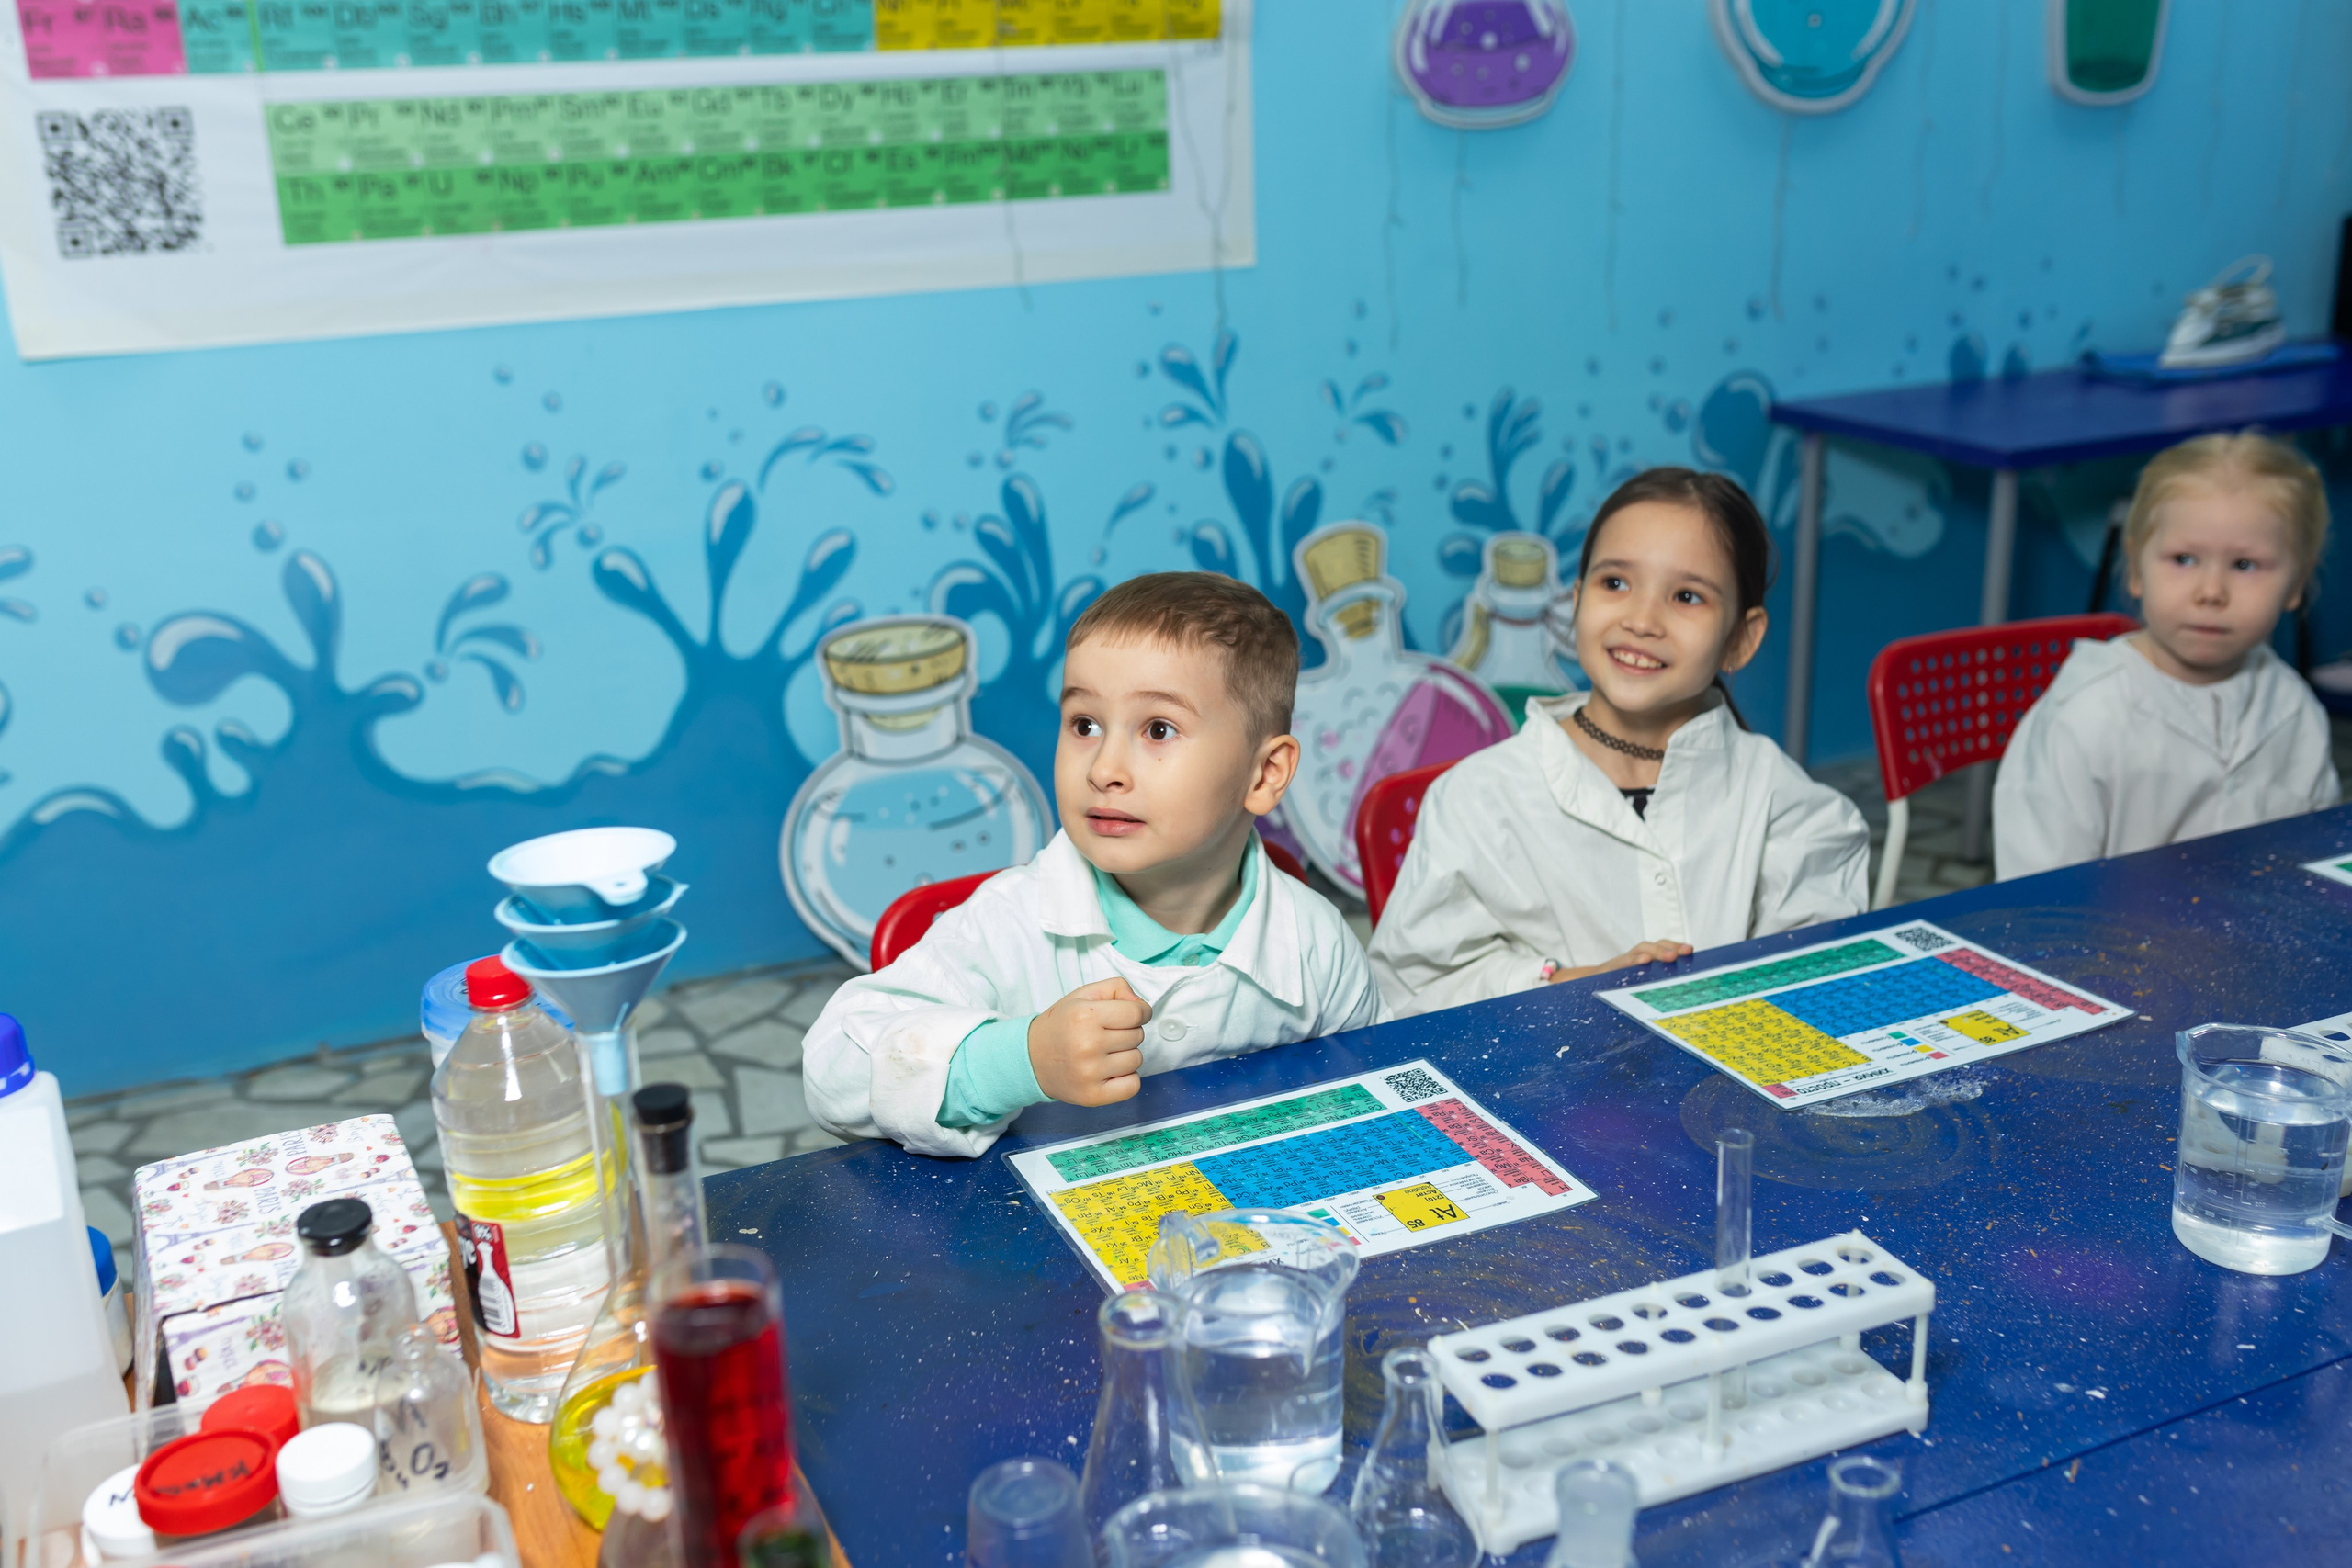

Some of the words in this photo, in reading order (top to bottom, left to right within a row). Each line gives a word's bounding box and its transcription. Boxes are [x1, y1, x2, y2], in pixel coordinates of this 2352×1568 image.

[1352, 1090, 1369, 1099] Th
[1315, 1100, 1325, 1109] U
[1348, 1108, 1361, 1116] Pr
[1409, 1114, 1423, 1122] Ac
[1220, 1121, 1238, 1129] Cm
[1277, 1123, 1295, 1132] Sm
[1446, 1122, 1463, 1130] Ba
[1200, 1125, 1216, 1134] Bk
[1257, 1128, 1273, 1136] Eu
[1425, 1127, 1441, 1135] La
[1483, 1128, 1500, 1136] Rb
[1234, 1134, 1250, 1143] Gd
[1342, 1131, 1360, 1139] Sg
[278, 1130, 308, 1157] PARIS
[1299, 1141, 1316, 1149] Hs
[1190, 1144, 1205, 1152] Dy
[1277, 1146, 1293, 1155] Mt
[1421, 1145, 1435, 1154] Zr
[1478, 1147, 1495, 1156] Ca
[1084, 1152, 1101, 1160] No
[1166, 1149, 1182, 1157] Ho
[1336, 1149, 1352, 1157] Re
[1147, 1155, 1159, 1163] Er
[1118, 1160, 1136, 1168] Tm
[1492, 1161, 1512, 1169] Mg
[1096, 1166, 1113, 1174] Yb
[1270, 1165, 1284, 1173] Pt
[1328, 1168, 1344, 1176] Ru
[1539, 1168, 1552, 1177] Li
[1073, 1170, 1089, 1179] Lu
[1165, 1173, 1177, 1181] Fl
[1244, 1170, 1259, 1179] Au
[1304, 1173, 1321, 1182] Rh
[1391, 1170, 1405, 1179] Cr
[1219, 1176, 1237, 1184] Hg
[1364, 1176, 1383, 1185] Mn
[1512, 1175, 1530, 1183] Be
[1201, 1182, 1215, 1190] Tl
[1282, 1179, 1298, 1188] Pd
[1344, 1181, 1360, 1190] Fe
[1115, 1184, 1129, 1192] Lv
[1174, 1188, 1190, 1196] Pb
[1258, 1184, 1273, 1192] Ag
[1319, 1188, 1336, 1196] Co
[1404, 1184, 1432, 1194] Astatine
[1234, 1190, 1250, 1200] Cd
[1299, 1193, 1313, 1201] Ni
[1415, 1189, 1437, 1198] Астат
[254, 1185, 283, 1215] PARIS
[1062, 1196, 1080, 1204] Og
[1125, 1199, 1142, 1207] Po
[1272, 1199, 1289, 1207] Cu
[1103, 1204, 1115, 1213] At
[1187, 1201, 1204, 1210] Sn
[1429, 1203, 1458, 1221] At
[1139, 1213, 1155, 1222] Te
[1407, 1218, 1426, 1229] 85
[1089, 1225, 1104, 1234] Xe
[1130, 1234, 1143, 1242] Br
[1104, 1240, 1118, 1248] Kr
[1117, 1256, 1129, 1264] Ar
[1126, 1272, 1145, 1280] Ne
